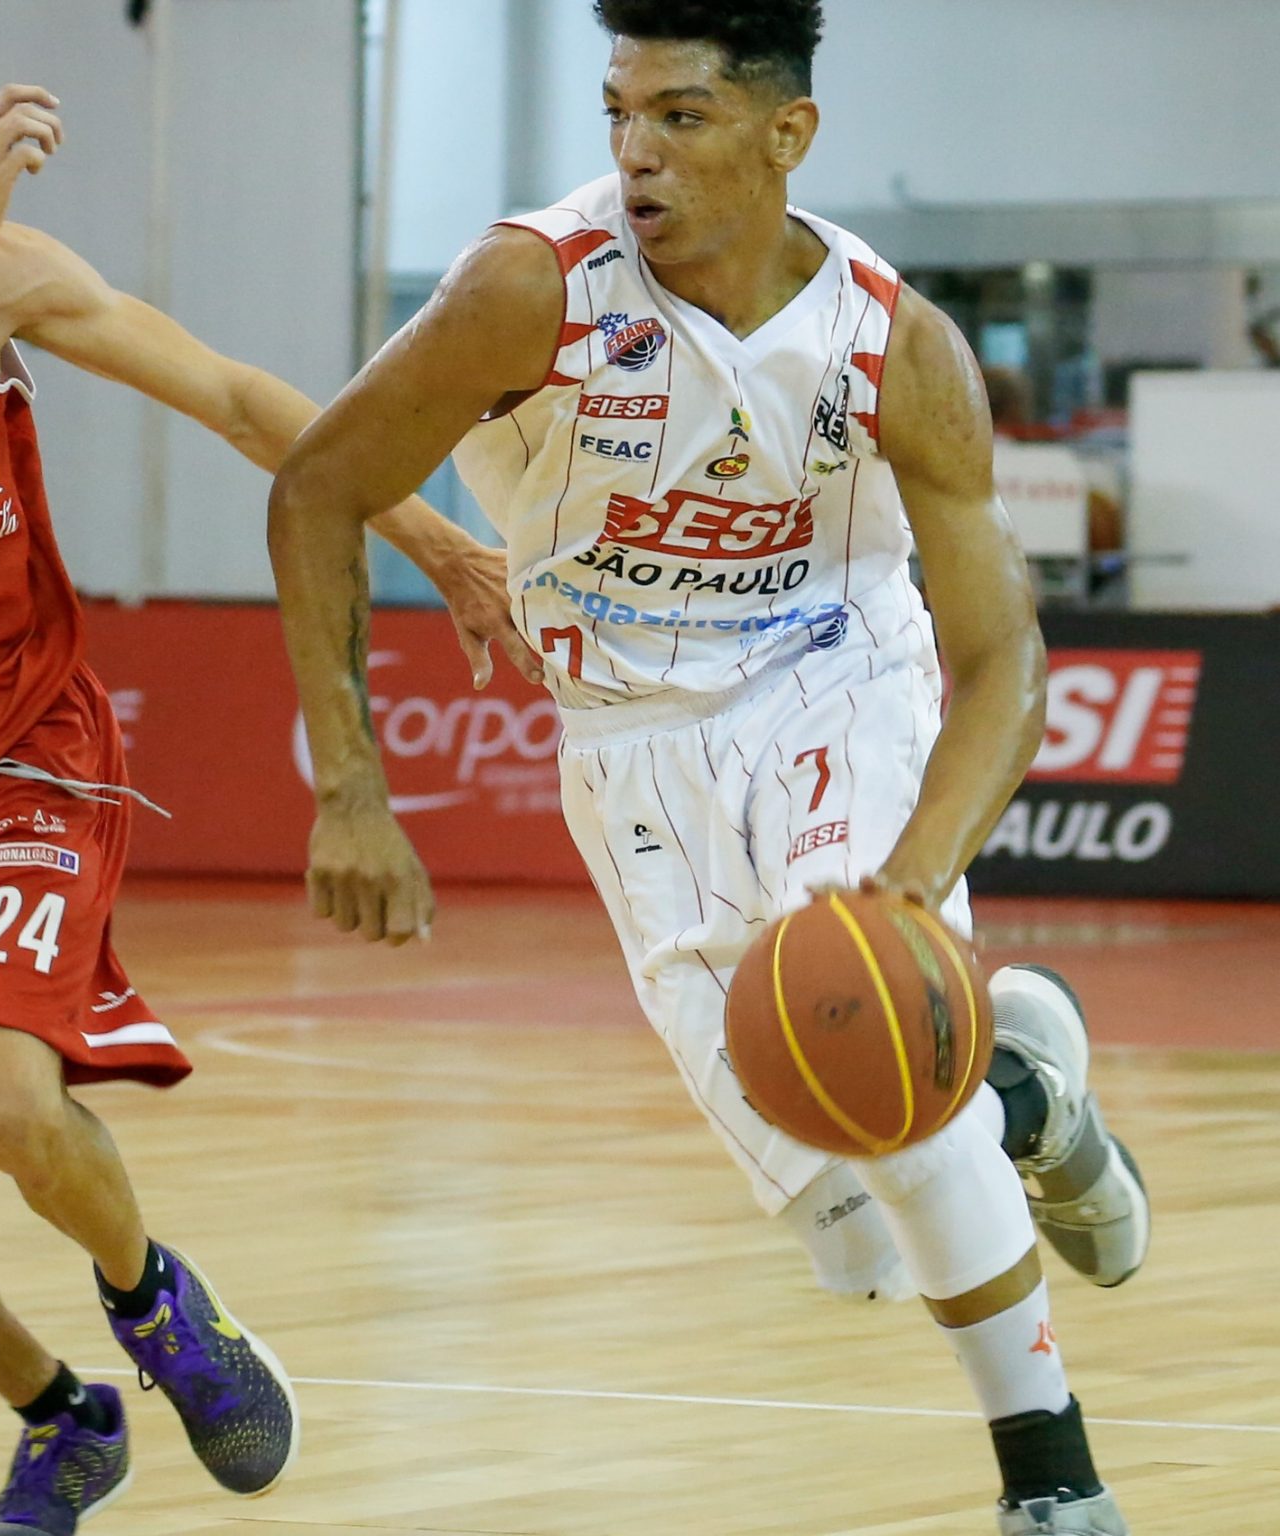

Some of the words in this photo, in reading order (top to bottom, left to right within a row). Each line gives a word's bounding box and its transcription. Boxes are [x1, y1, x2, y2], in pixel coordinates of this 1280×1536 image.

[585, 398, 662, 417] FIESP
[580, 434, 652, 459] FEAC
[616, 498, 805, 552] SESI
[574, 545, 662, 586] SÃO
[670, 559, 810, 595] PAULO
[540, 624, 583, 680] 7
[370, 696, 563, 781] orpo
[1025, 664, 1163, 771] SI
[793, 746, 831, 815] 7
[980, 800, 1172, 861] AULO
